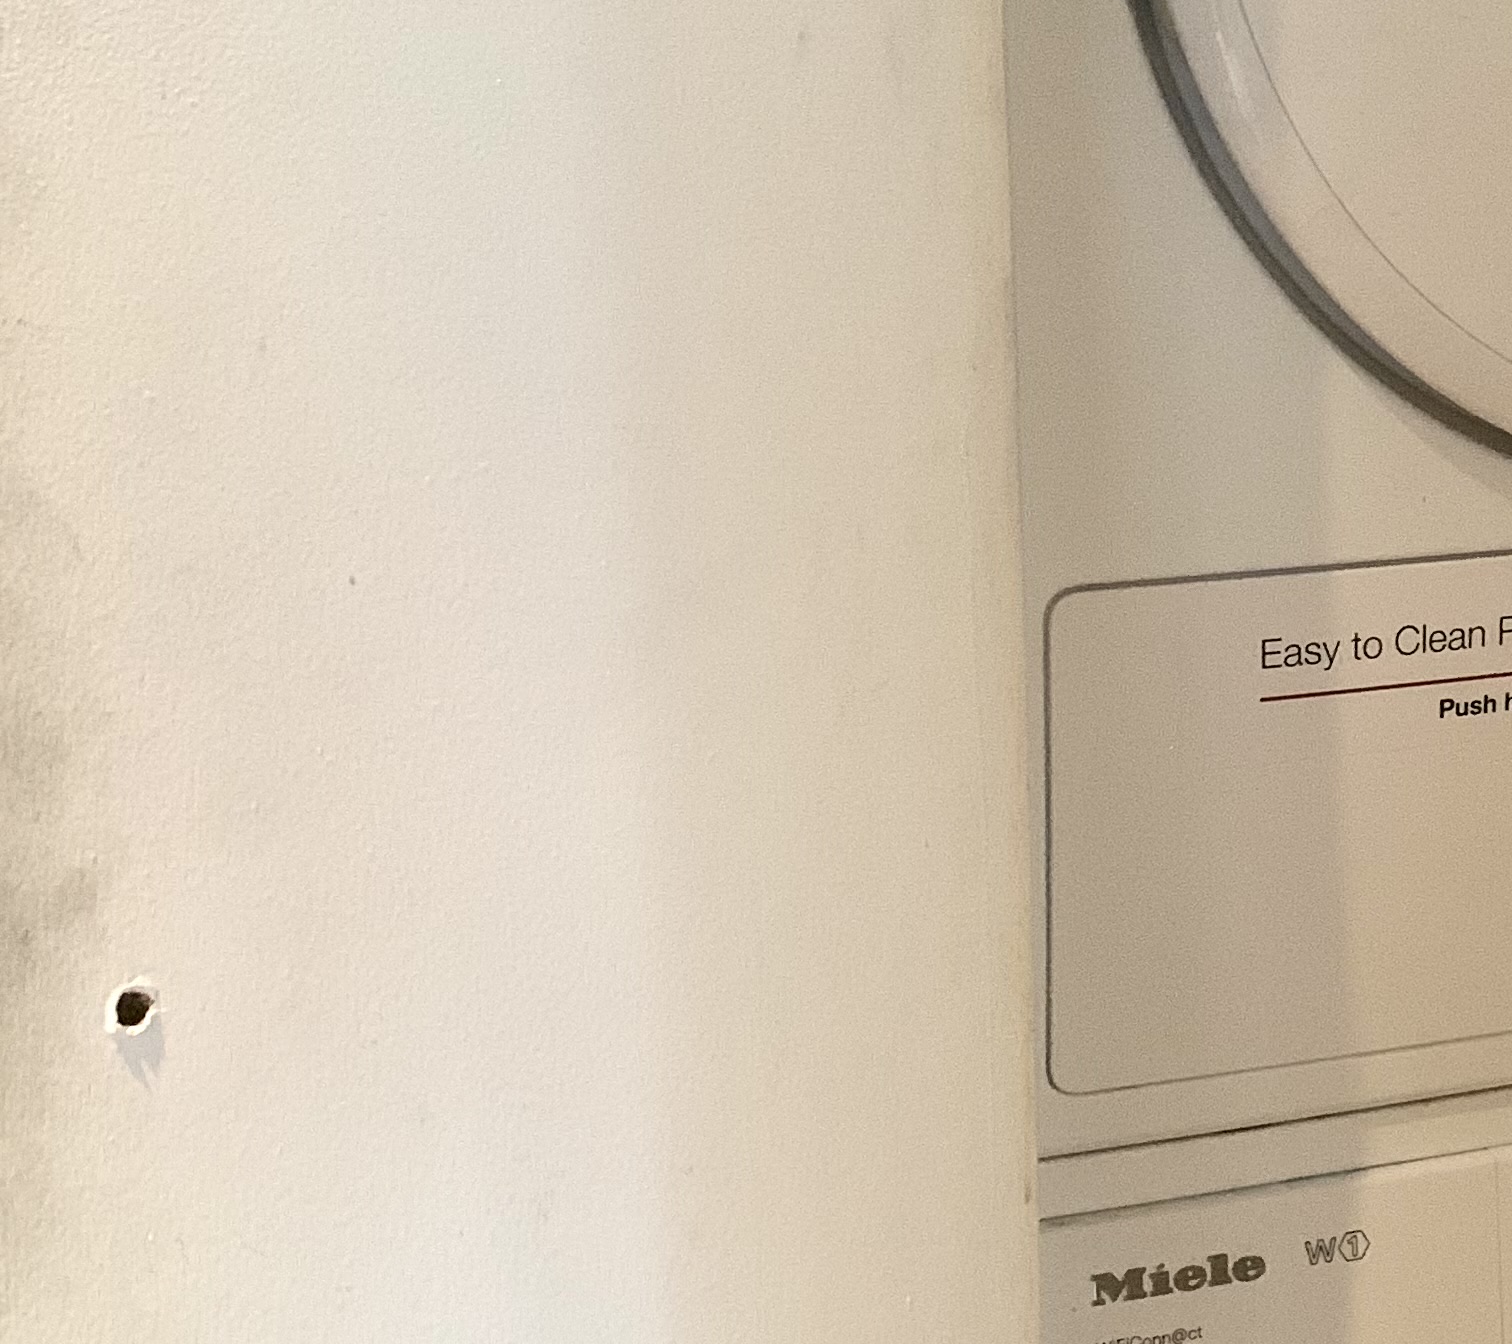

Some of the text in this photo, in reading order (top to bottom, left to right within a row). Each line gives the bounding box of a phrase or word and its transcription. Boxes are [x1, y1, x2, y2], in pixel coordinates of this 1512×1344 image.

[1260, 637, 1341, 671] Easy
[1352, 632, 1383, 661] to
[1394, 623, 1487, 656] Clean
[1438, 698, 1498, 719] Push
[1090, 1253, 1267, 1307] Miele
